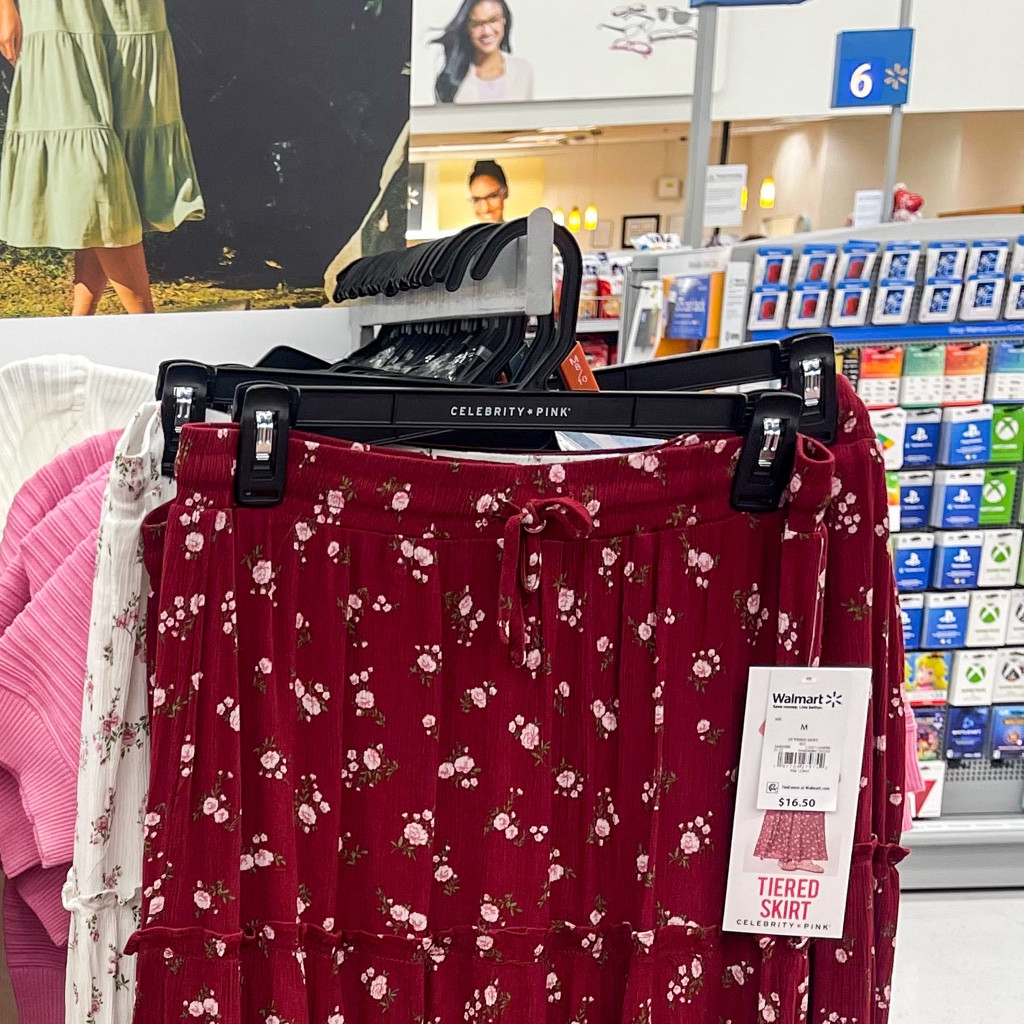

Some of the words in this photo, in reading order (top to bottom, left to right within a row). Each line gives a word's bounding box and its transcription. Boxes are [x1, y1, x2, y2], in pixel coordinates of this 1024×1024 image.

[849, 62, 874, 98] 6
[569, 354, 580, 366] M
[450, 406, 525, 417] CELEBRITY
[536, 407, 568, 417] PINK
[772, 693, 824, 705] Walmart
[800, 723, 808, 731] M
[778, 797, 816, 808] $16.50
[758, 877, 820, 899] TIERED
[760, 899, 812, 920] SKIRT
[736, 919, 795, 929] CELEBRITY
